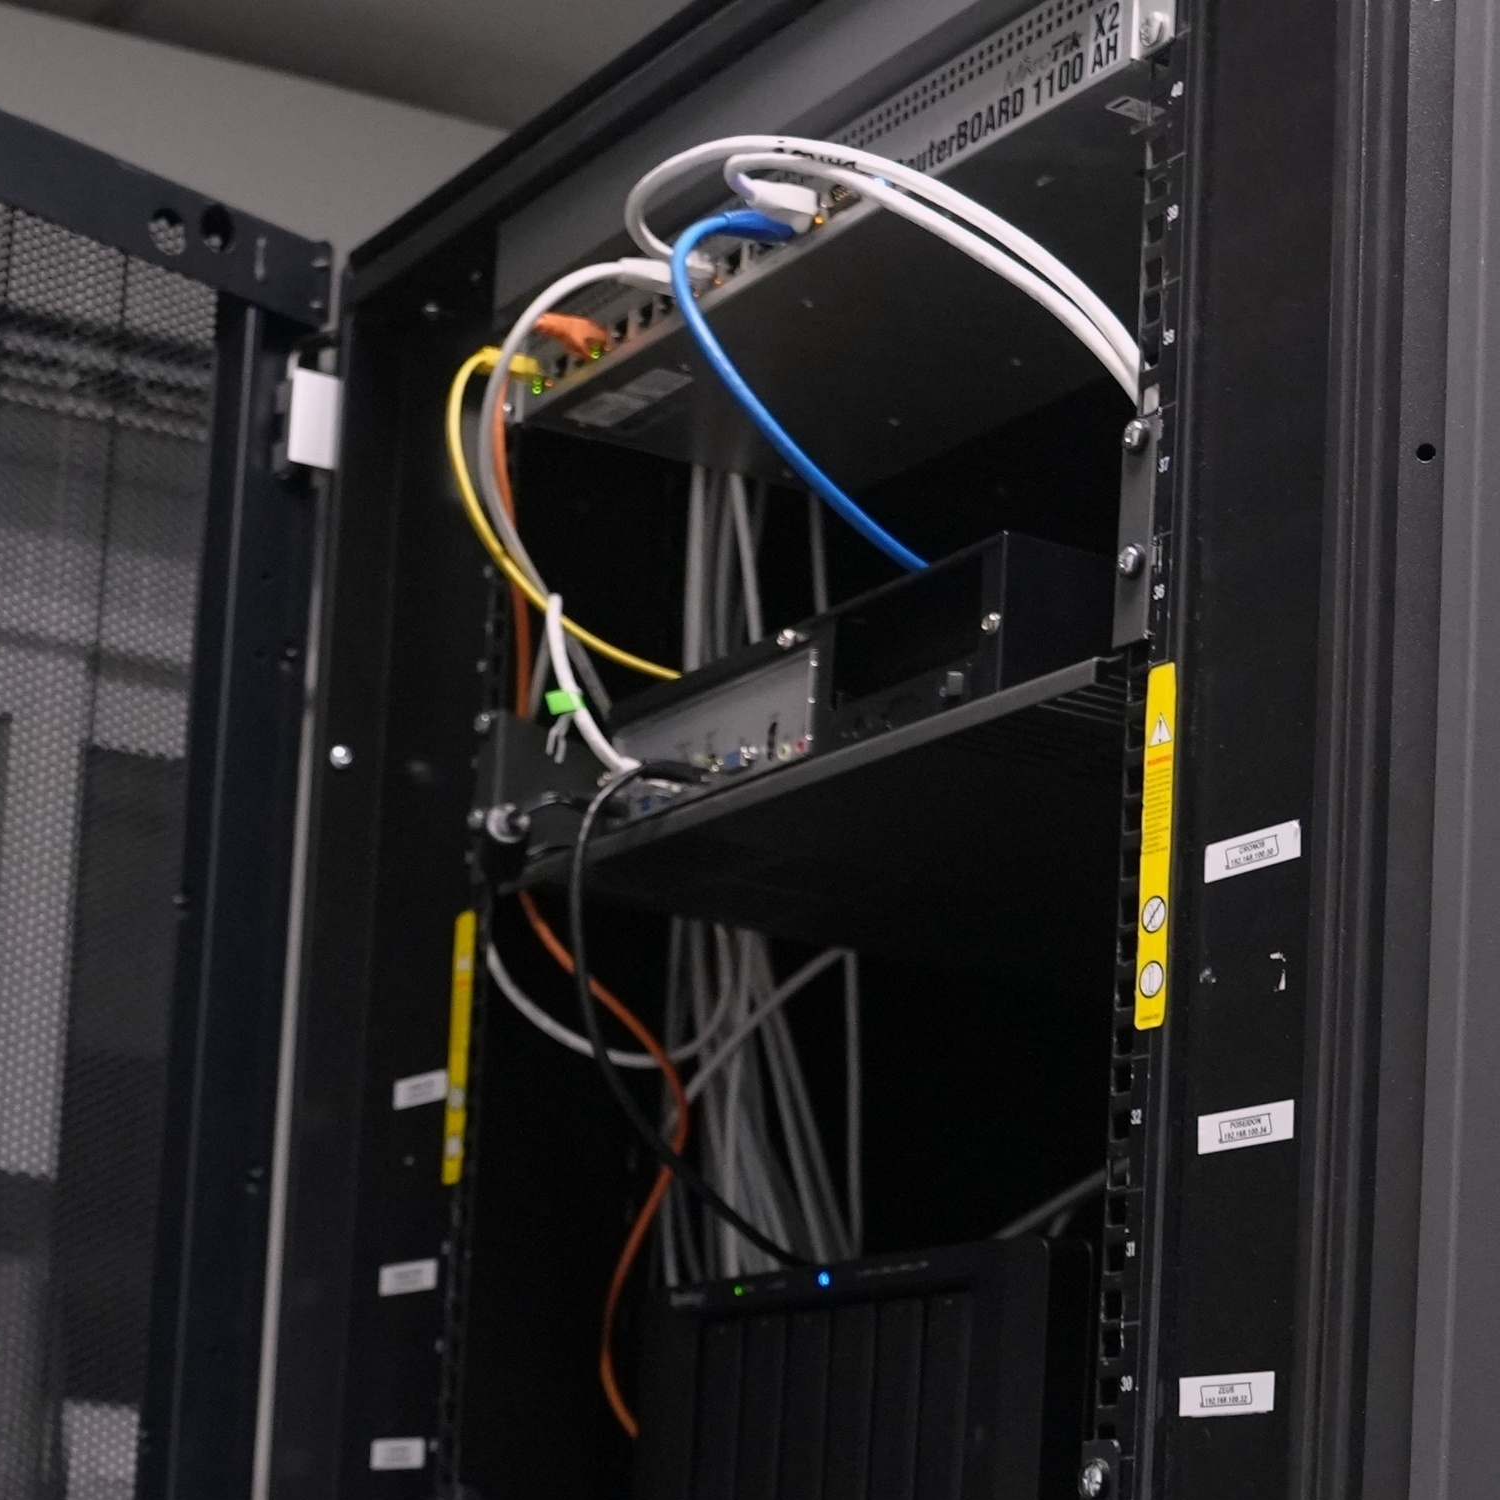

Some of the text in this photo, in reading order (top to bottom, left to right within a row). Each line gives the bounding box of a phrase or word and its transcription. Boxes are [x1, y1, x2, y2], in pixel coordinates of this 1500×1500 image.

[1094, 2, 1119, 41] X2
[898, 88, 1024, 173] uterBOARD
[1033, 53, 1083, 106] 1100
[1092, 34, 1118, 73] AH
[1158, 456, 1170, 473] 37
[1153, 583, 1165, 600] 36
[1125, 1241, 1136, 1257] 31
[1120, 1375, 1133, 1392] 30
[1218, 1385, 1235, 1394] ZEUS
